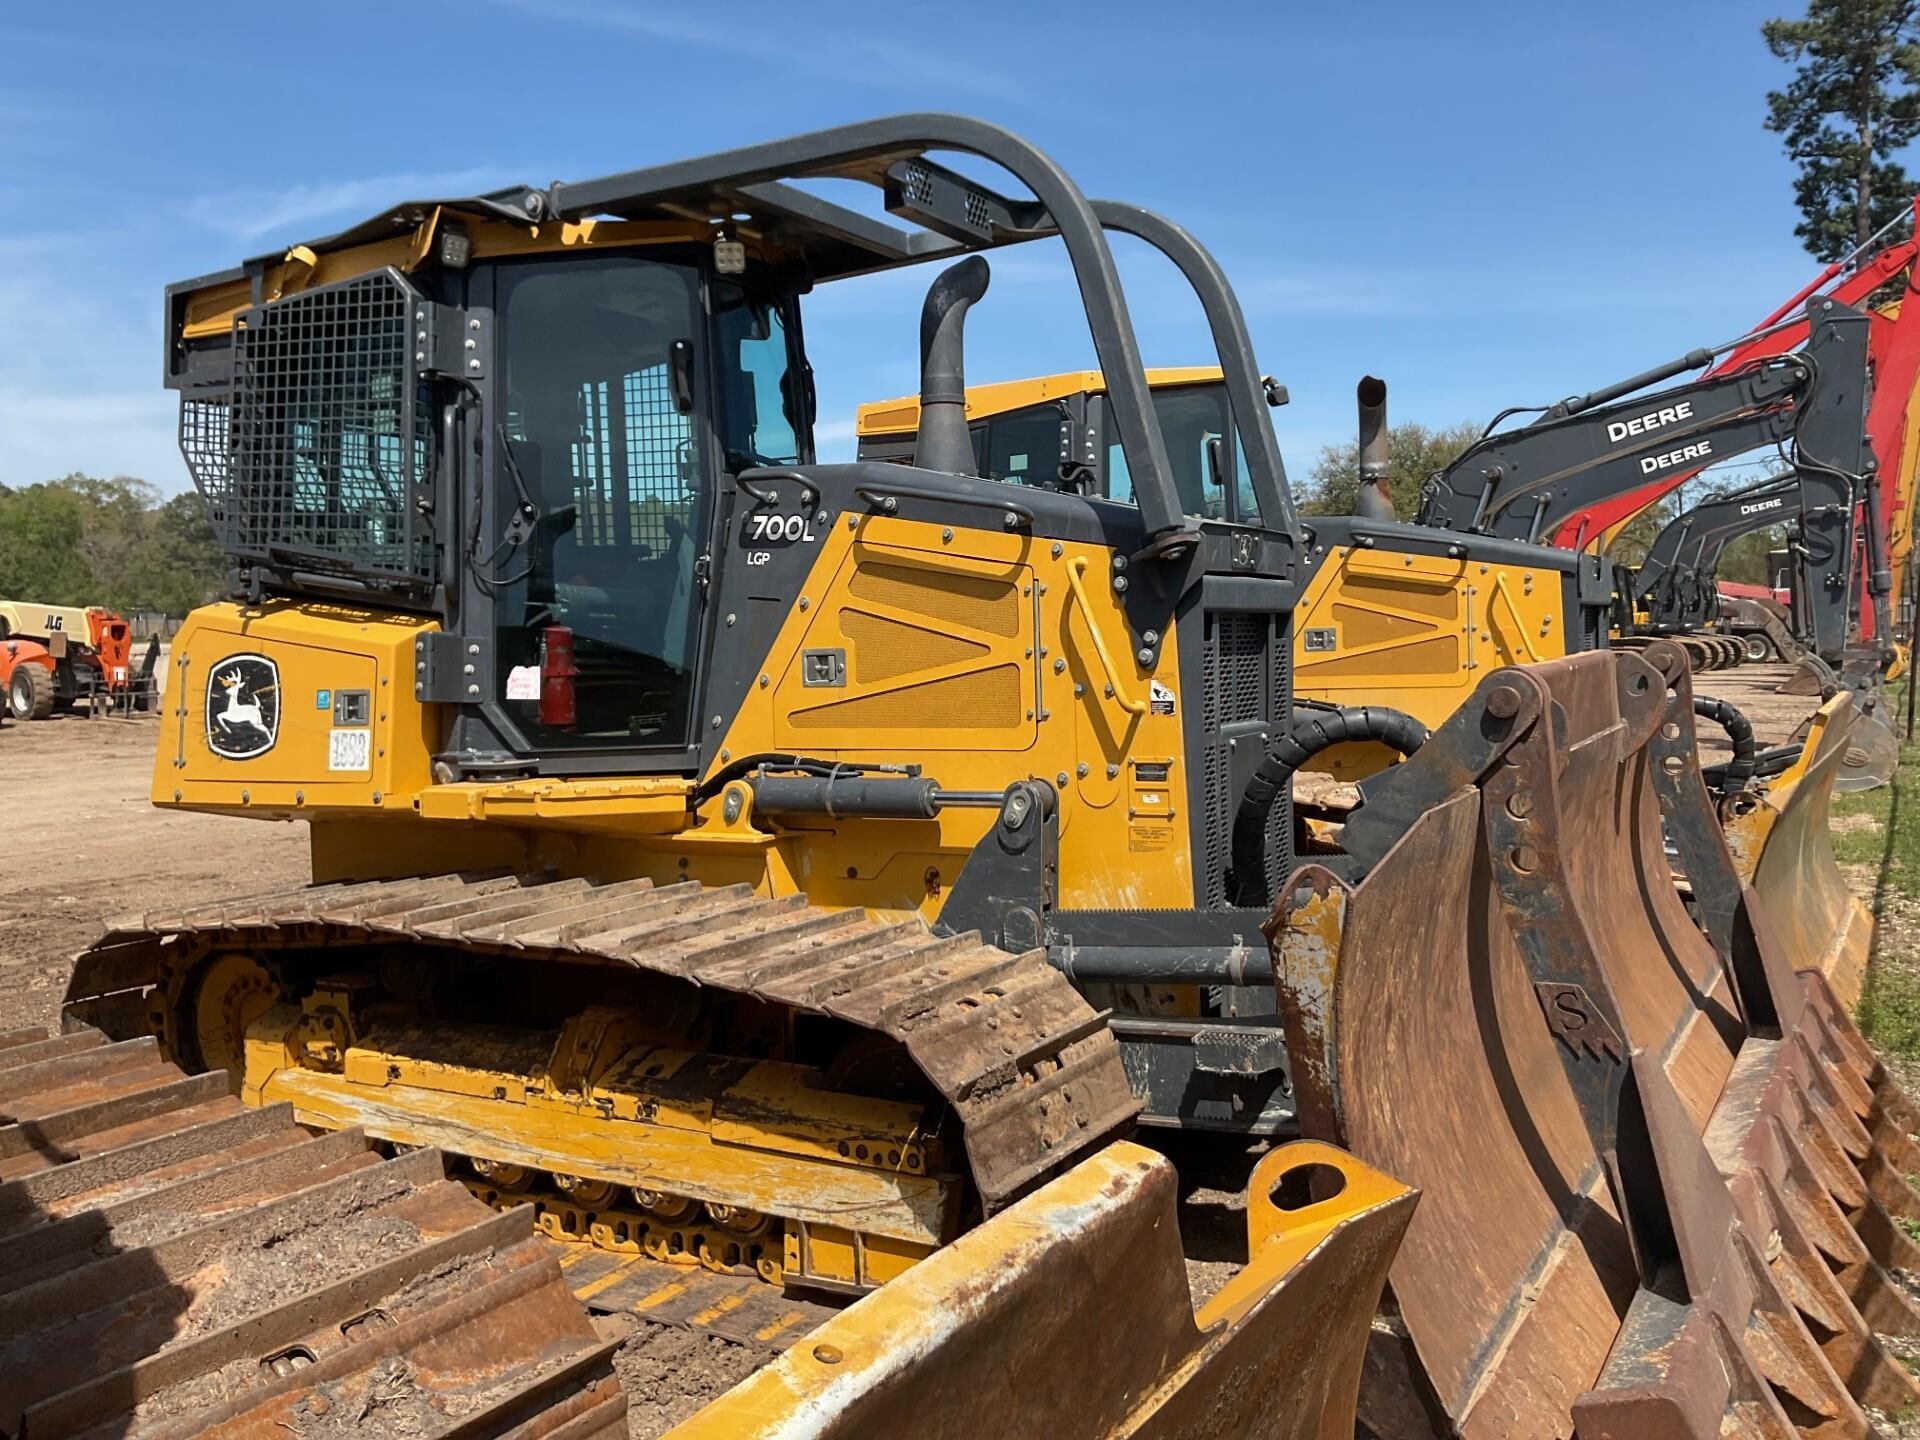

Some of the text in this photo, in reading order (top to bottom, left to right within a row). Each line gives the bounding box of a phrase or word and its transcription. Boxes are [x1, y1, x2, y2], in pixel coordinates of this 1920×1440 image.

[1607, 401, 1693, 442] DEERE
[1640, 440, 1712, 473] DEERE
[1740, 498, 1782, 515] DEERE
[752, 515, 815, 541] 700L
[747, 552, 770, 565] LGP
[45, 614, 62, 630] JLG
